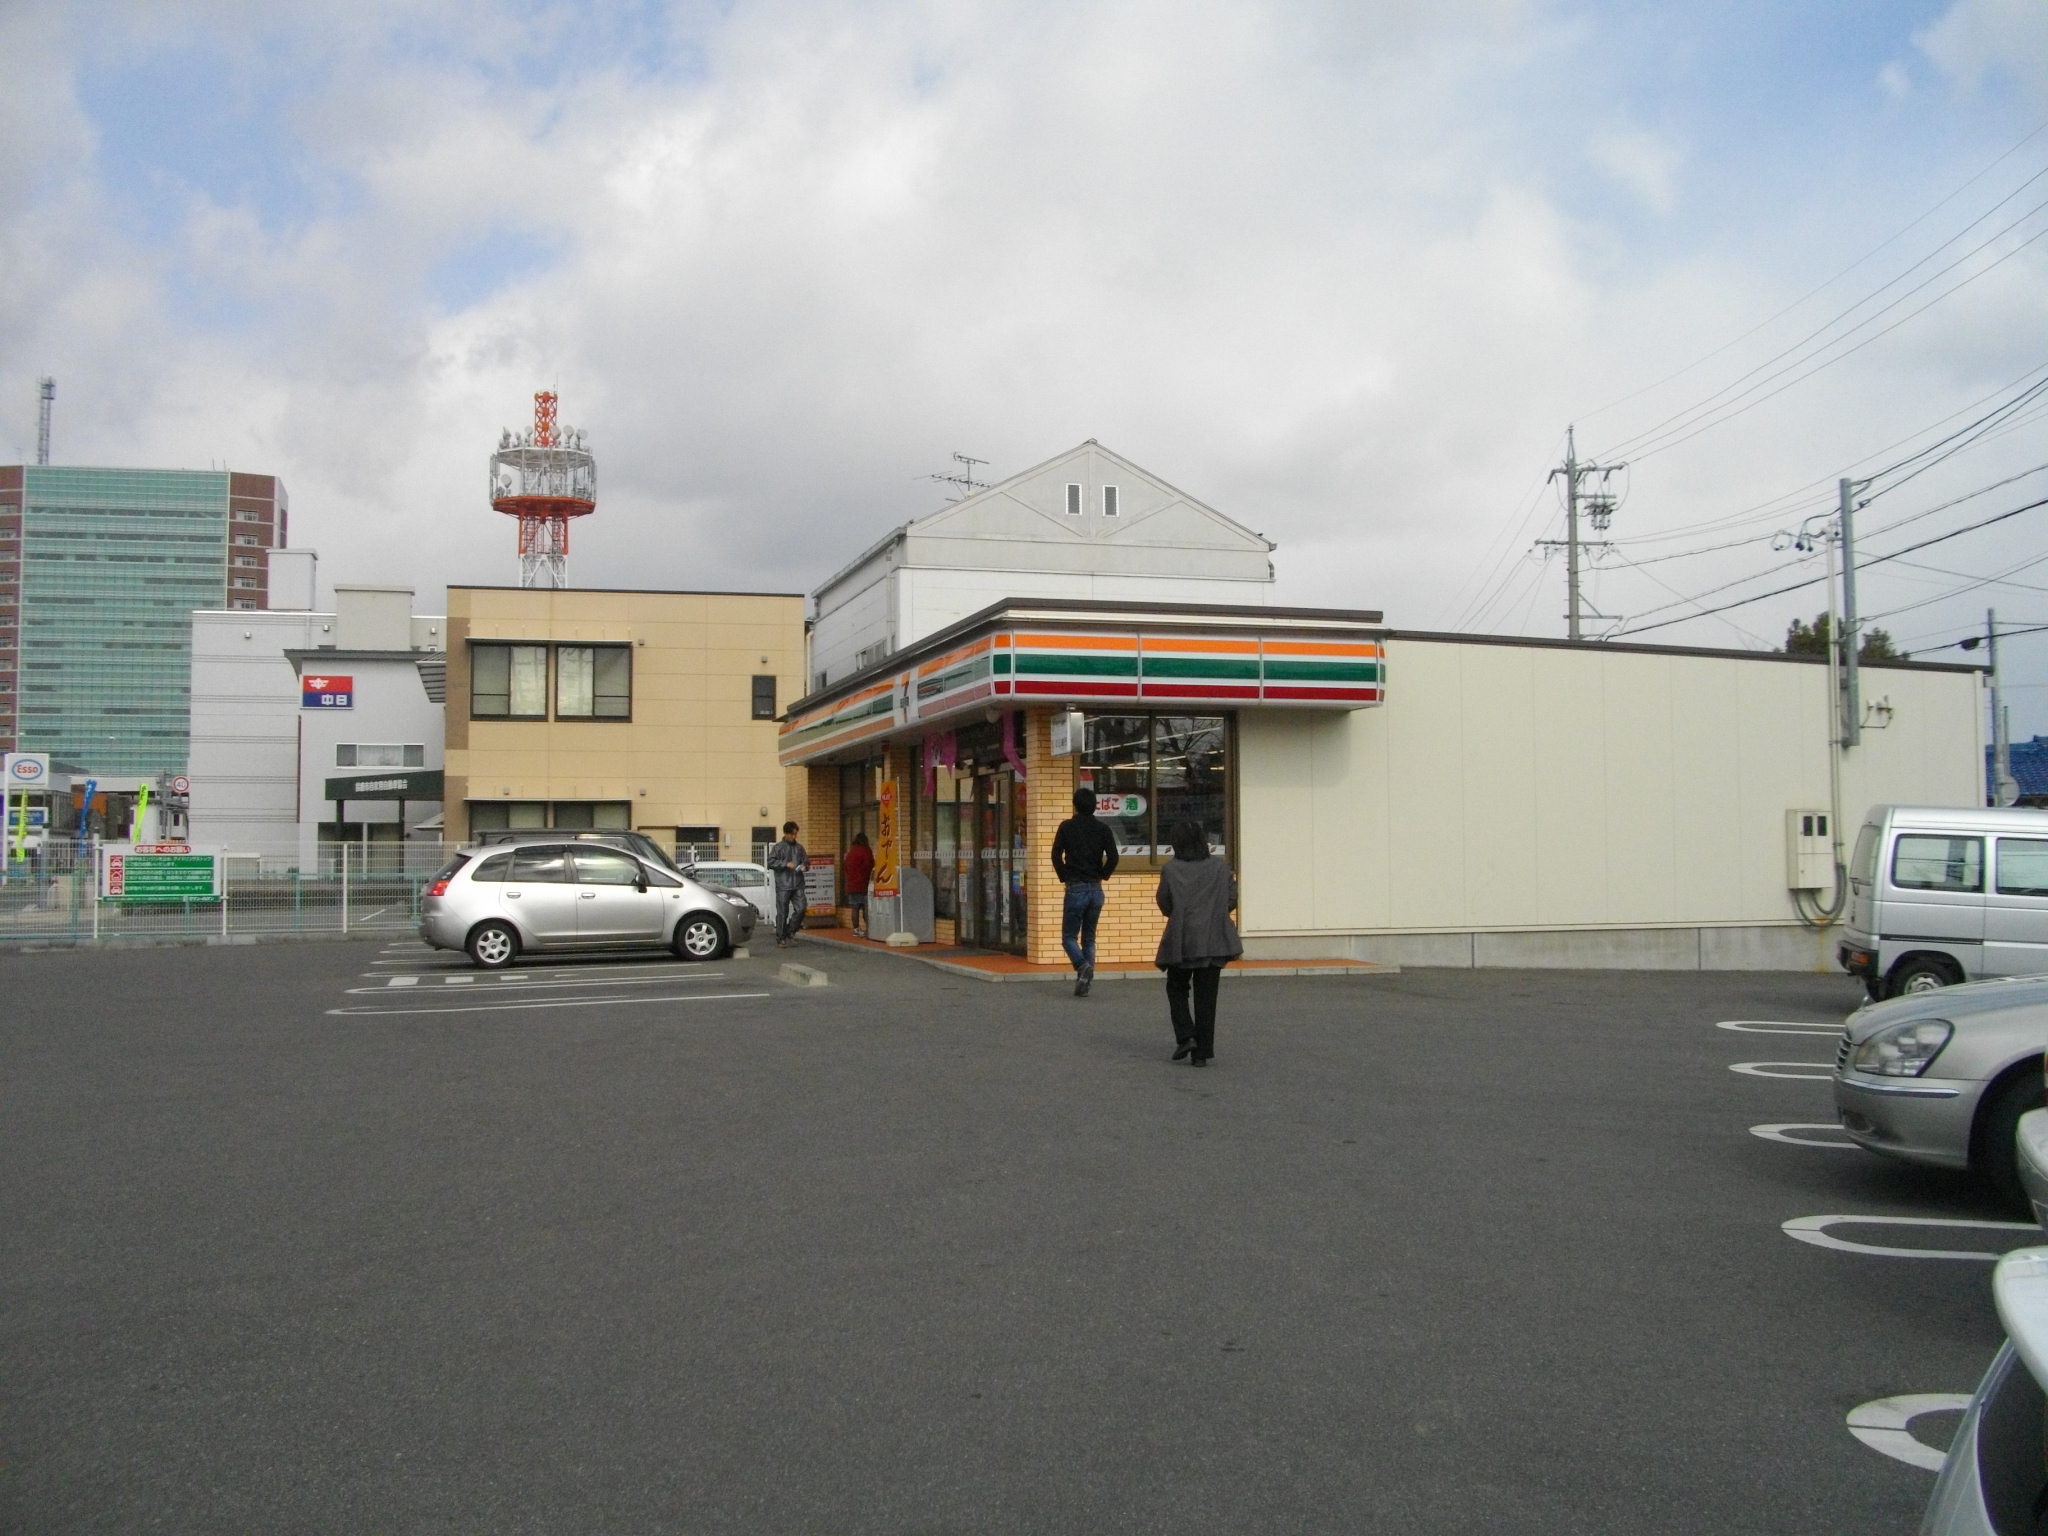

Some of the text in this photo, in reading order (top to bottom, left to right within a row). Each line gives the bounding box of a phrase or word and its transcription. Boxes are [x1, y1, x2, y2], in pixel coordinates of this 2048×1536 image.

[321, 694, 348, 705] 中日
[17, 765, 38, 773] Esso
[1125, 797, 1138, 810] 酒
[876, 813, 893, 885] おでん
